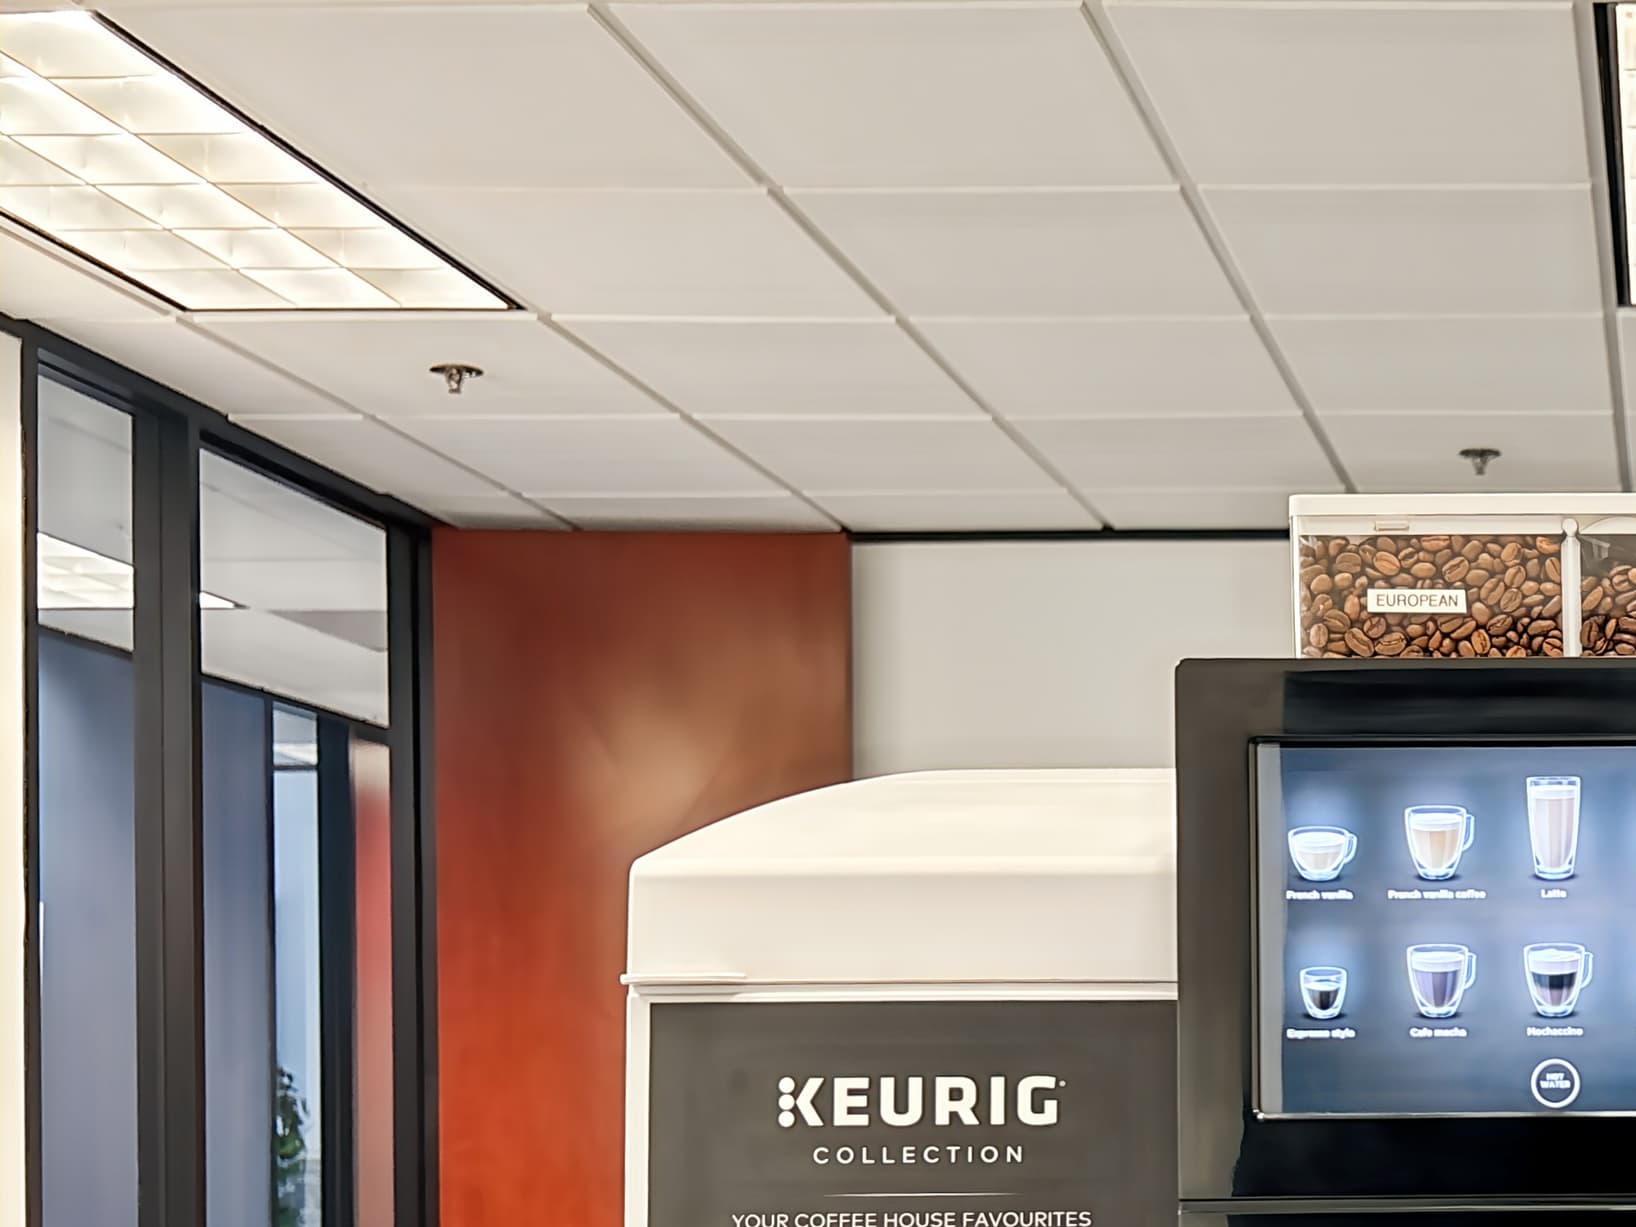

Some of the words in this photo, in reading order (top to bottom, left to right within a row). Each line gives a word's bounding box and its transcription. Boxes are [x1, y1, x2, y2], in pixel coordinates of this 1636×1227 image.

[1376, 594, 1458, 607] EUROPEAN
[779, 1075, 1060, 1128] KEURIG
[813, 1146, 1023, 1165] COLLECTION
[963, 1211, 1092, 1227] FAVOURITES
